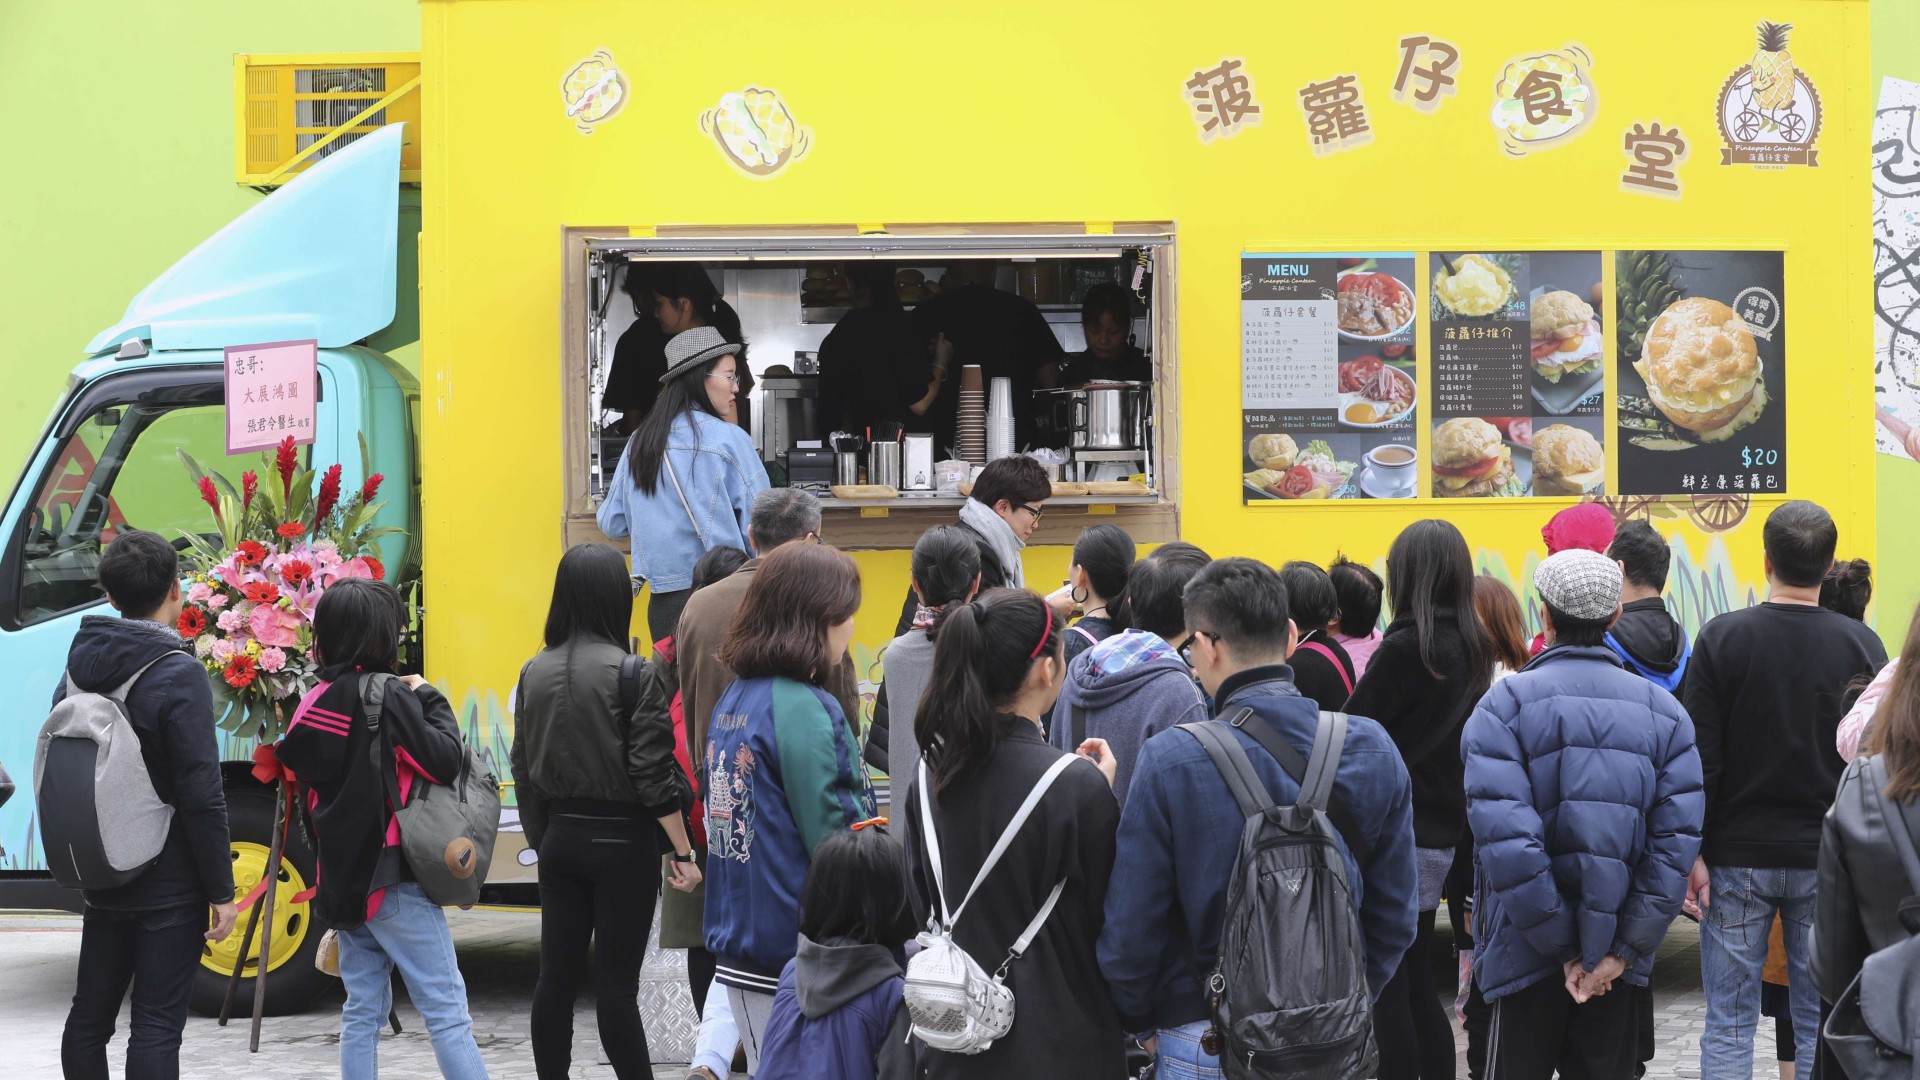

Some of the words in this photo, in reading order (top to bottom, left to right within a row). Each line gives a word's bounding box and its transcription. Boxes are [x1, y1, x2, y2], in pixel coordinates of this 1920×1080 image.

[1267, 264, 1309, 276] MENU
[1507, 301, 1525, 311] $48
[1444, 326, 1513, 339] 菠蘿仔推介
[243, 381, 298, 405] 大展鴻圖
[1581, 395, 1601, 406] $27
[1741, 445, 1778, 469] $20
